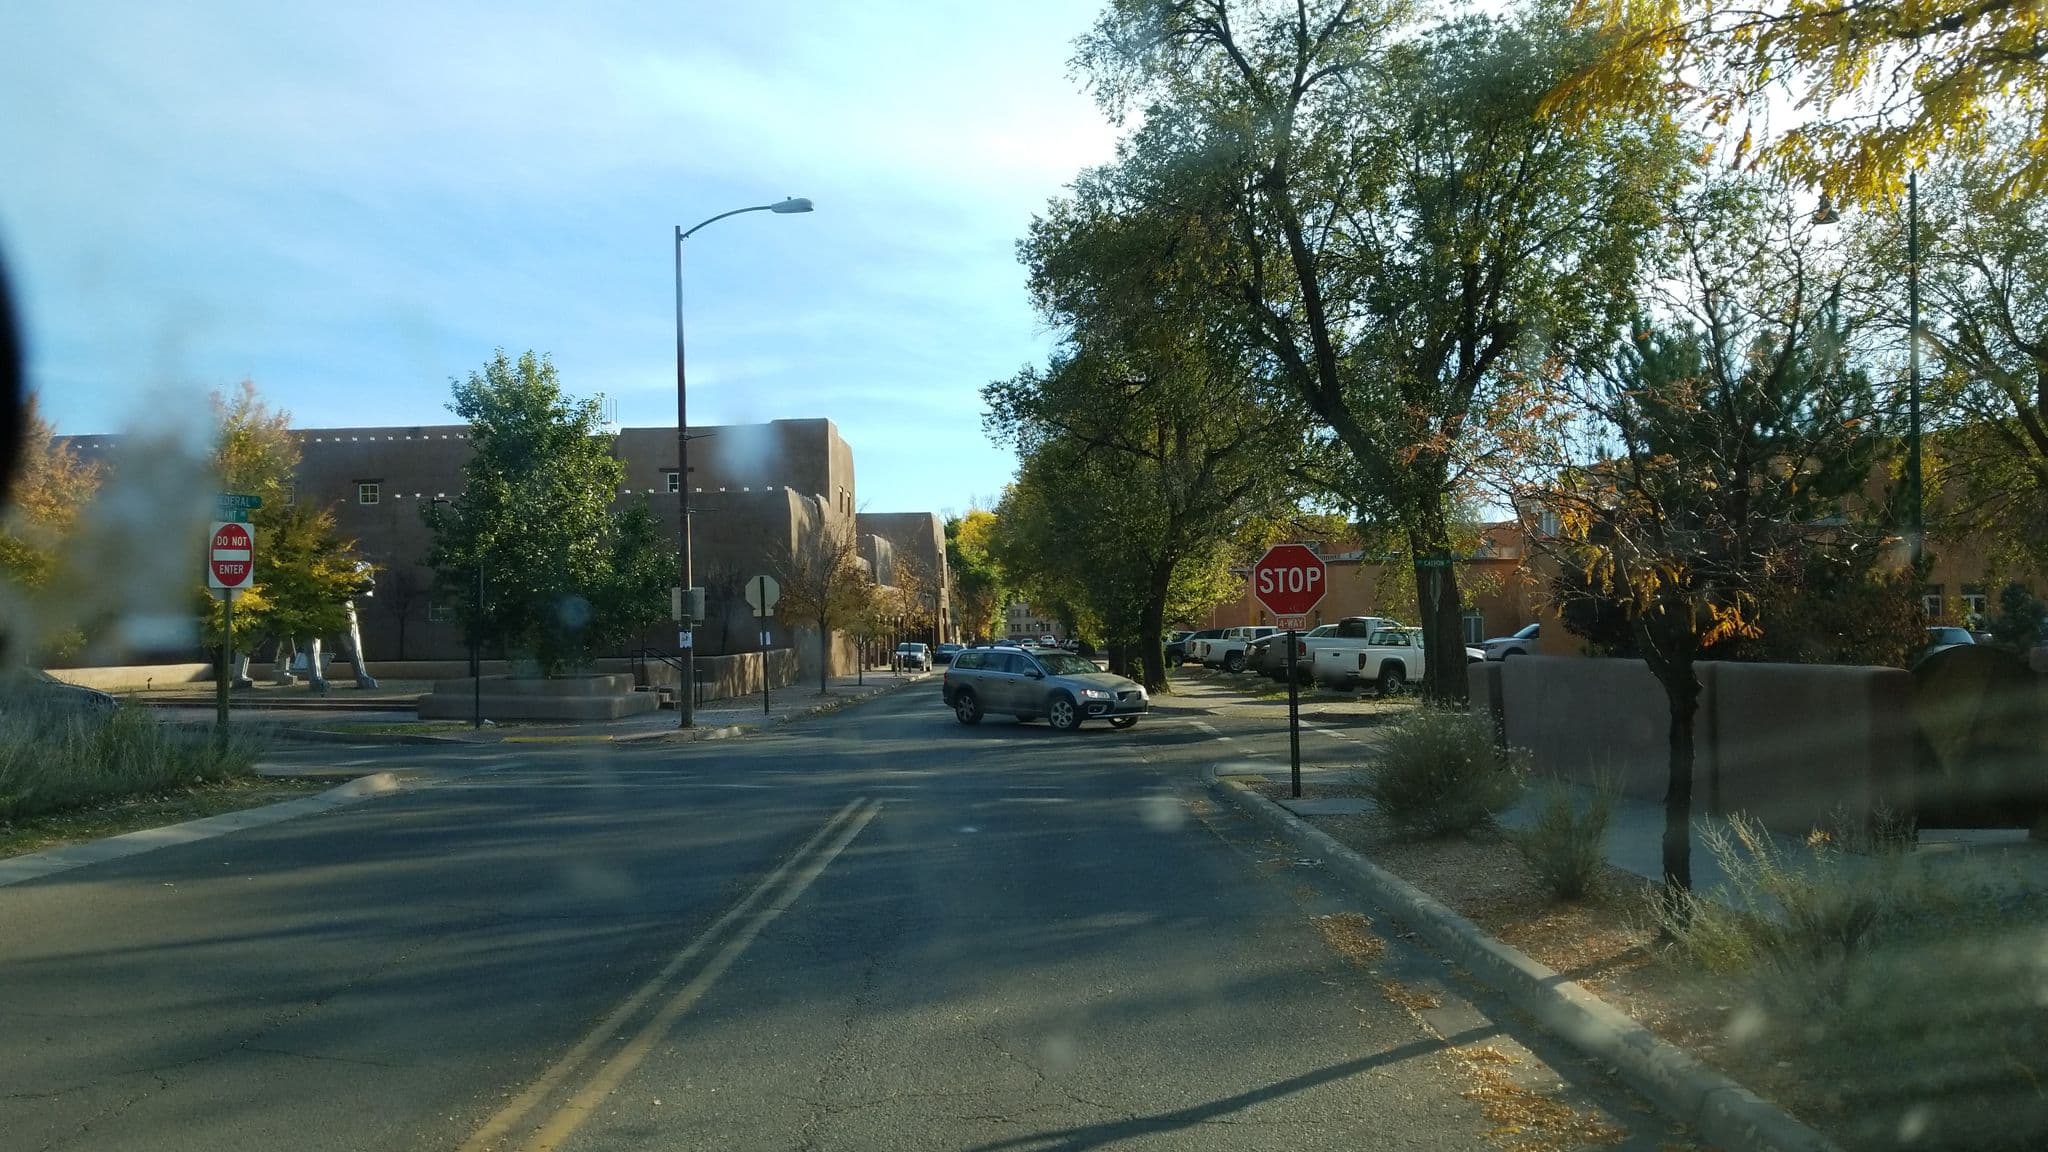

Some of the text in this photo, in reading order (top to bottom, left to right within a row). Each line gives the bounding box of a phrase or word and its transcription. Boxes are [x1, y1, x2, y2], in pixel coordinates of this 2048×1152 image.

[216, 535, 248, 546] DO NOT
[219, 564, 244, 575] ENTER
[1259, 566, 1321, 594] STOP
[1279, 618, 1304, 628] 4-WAY
